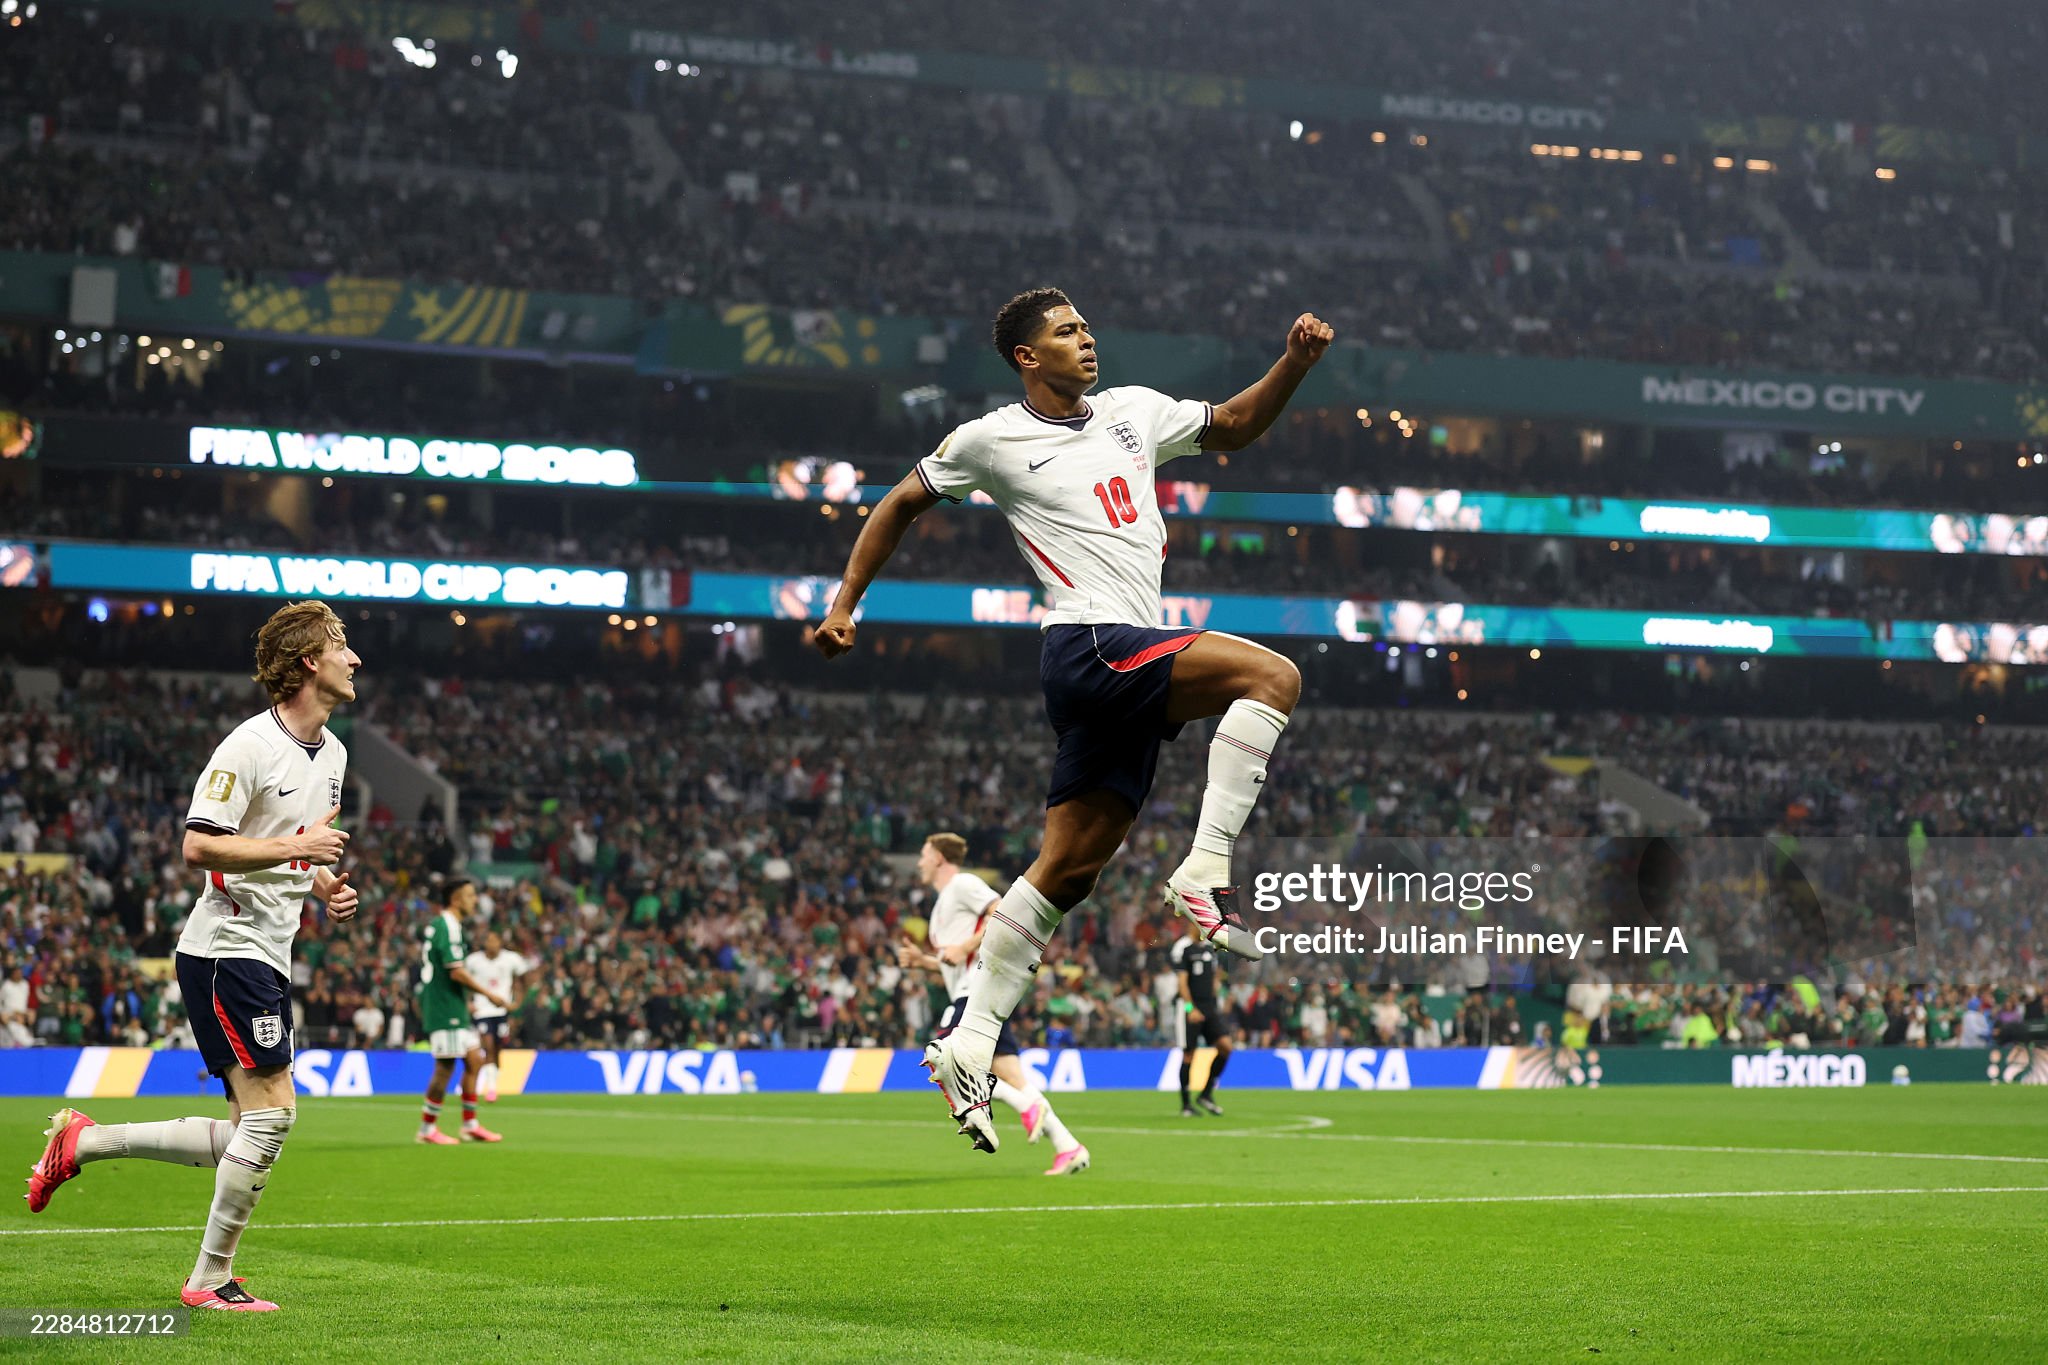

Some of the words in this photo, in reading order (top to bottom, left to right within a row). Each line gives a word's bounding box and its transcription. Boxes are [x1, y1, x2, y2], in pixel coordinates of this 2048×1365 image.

[1382, 95, 1523, 125] MEXICO
[1642, 376, 1817, 410] MEXICO
[1823, 384, 1925, 416] CITY
[190, 426, 277, 467] FIFA
[276, 431, 421, 475] WORLD
[421, 439, 502, 478] CUP
[1093, 476, 1138, 529] 10
[191, 553, 279, 592] FIFA
[277, 556, 422, 598] WORLD
[422, 563, 502, 601] CUP
[293, 1049, 374, 1096] SA
[587, 1050, 742, 1095] VISA
[1019, 1048, 1087, 1092] SA
[1274, 1048, 1412, 1091] VISA
[1732, 1048, 1867, 1087] MÉXICO
